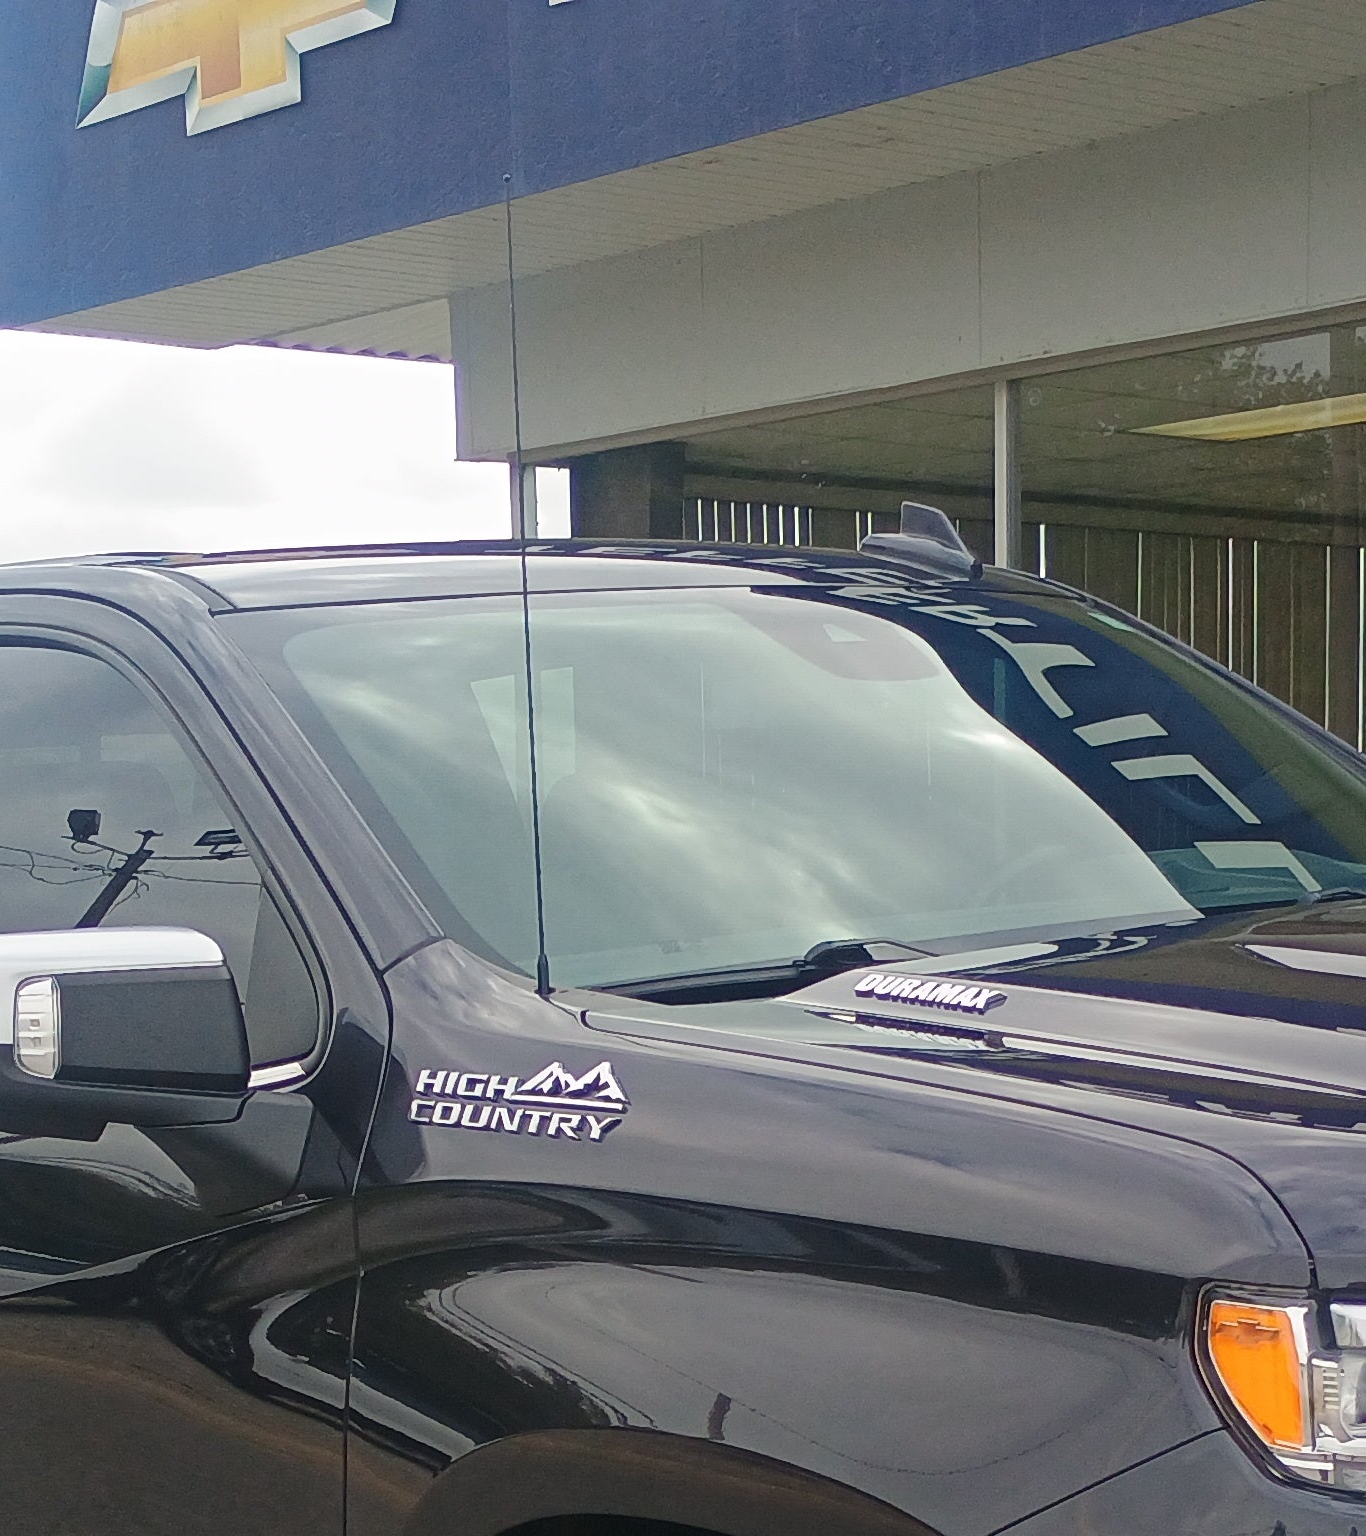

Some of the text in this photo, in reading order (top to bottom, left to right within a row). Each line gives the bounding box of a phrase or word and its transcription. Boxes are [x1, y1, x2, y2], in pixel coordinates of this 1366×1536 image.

[854, 973, 1001, 1011] DURAMAX
[415, 1068, 520, 1101] HIGH
[409, 1099, 623, 1141] COUNTRY
